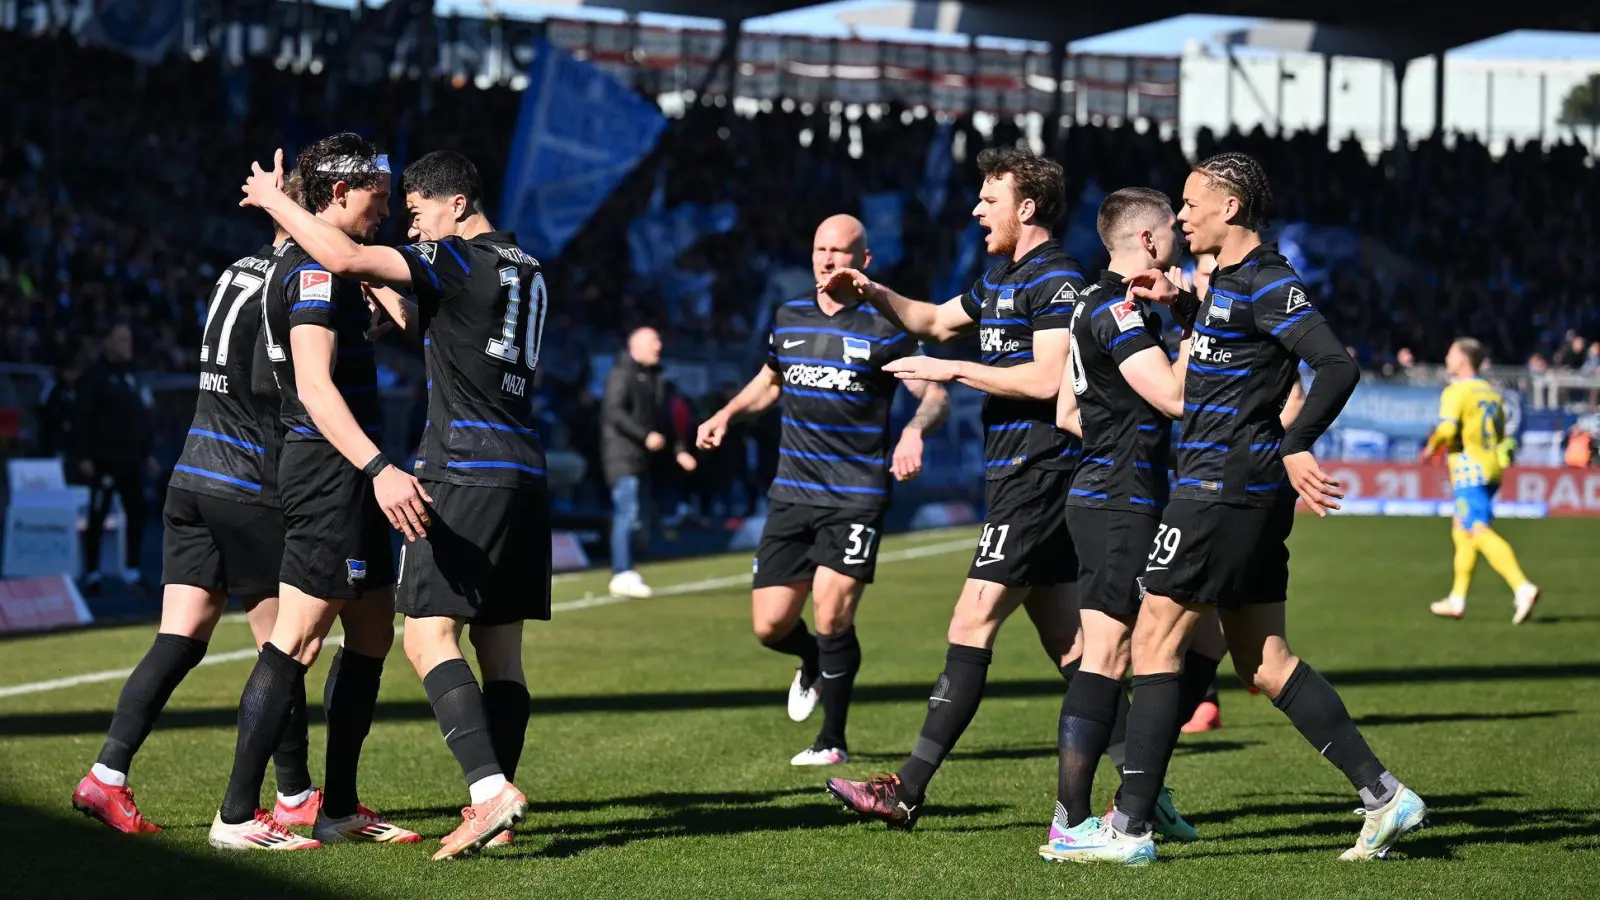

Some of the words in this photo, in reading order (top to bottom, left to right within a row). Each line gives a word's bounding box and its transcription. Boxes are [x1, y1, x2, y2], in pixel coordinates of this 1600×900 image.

[485, 266, 548, 370] 10
[502, 372, 526, 397] MAZA
[1376, 469, 1419, 500] 21
[845, 523, 876, 559] 37
[979, 522, 1010, 560] 41
[1148, 523, 1181, 565] 39
